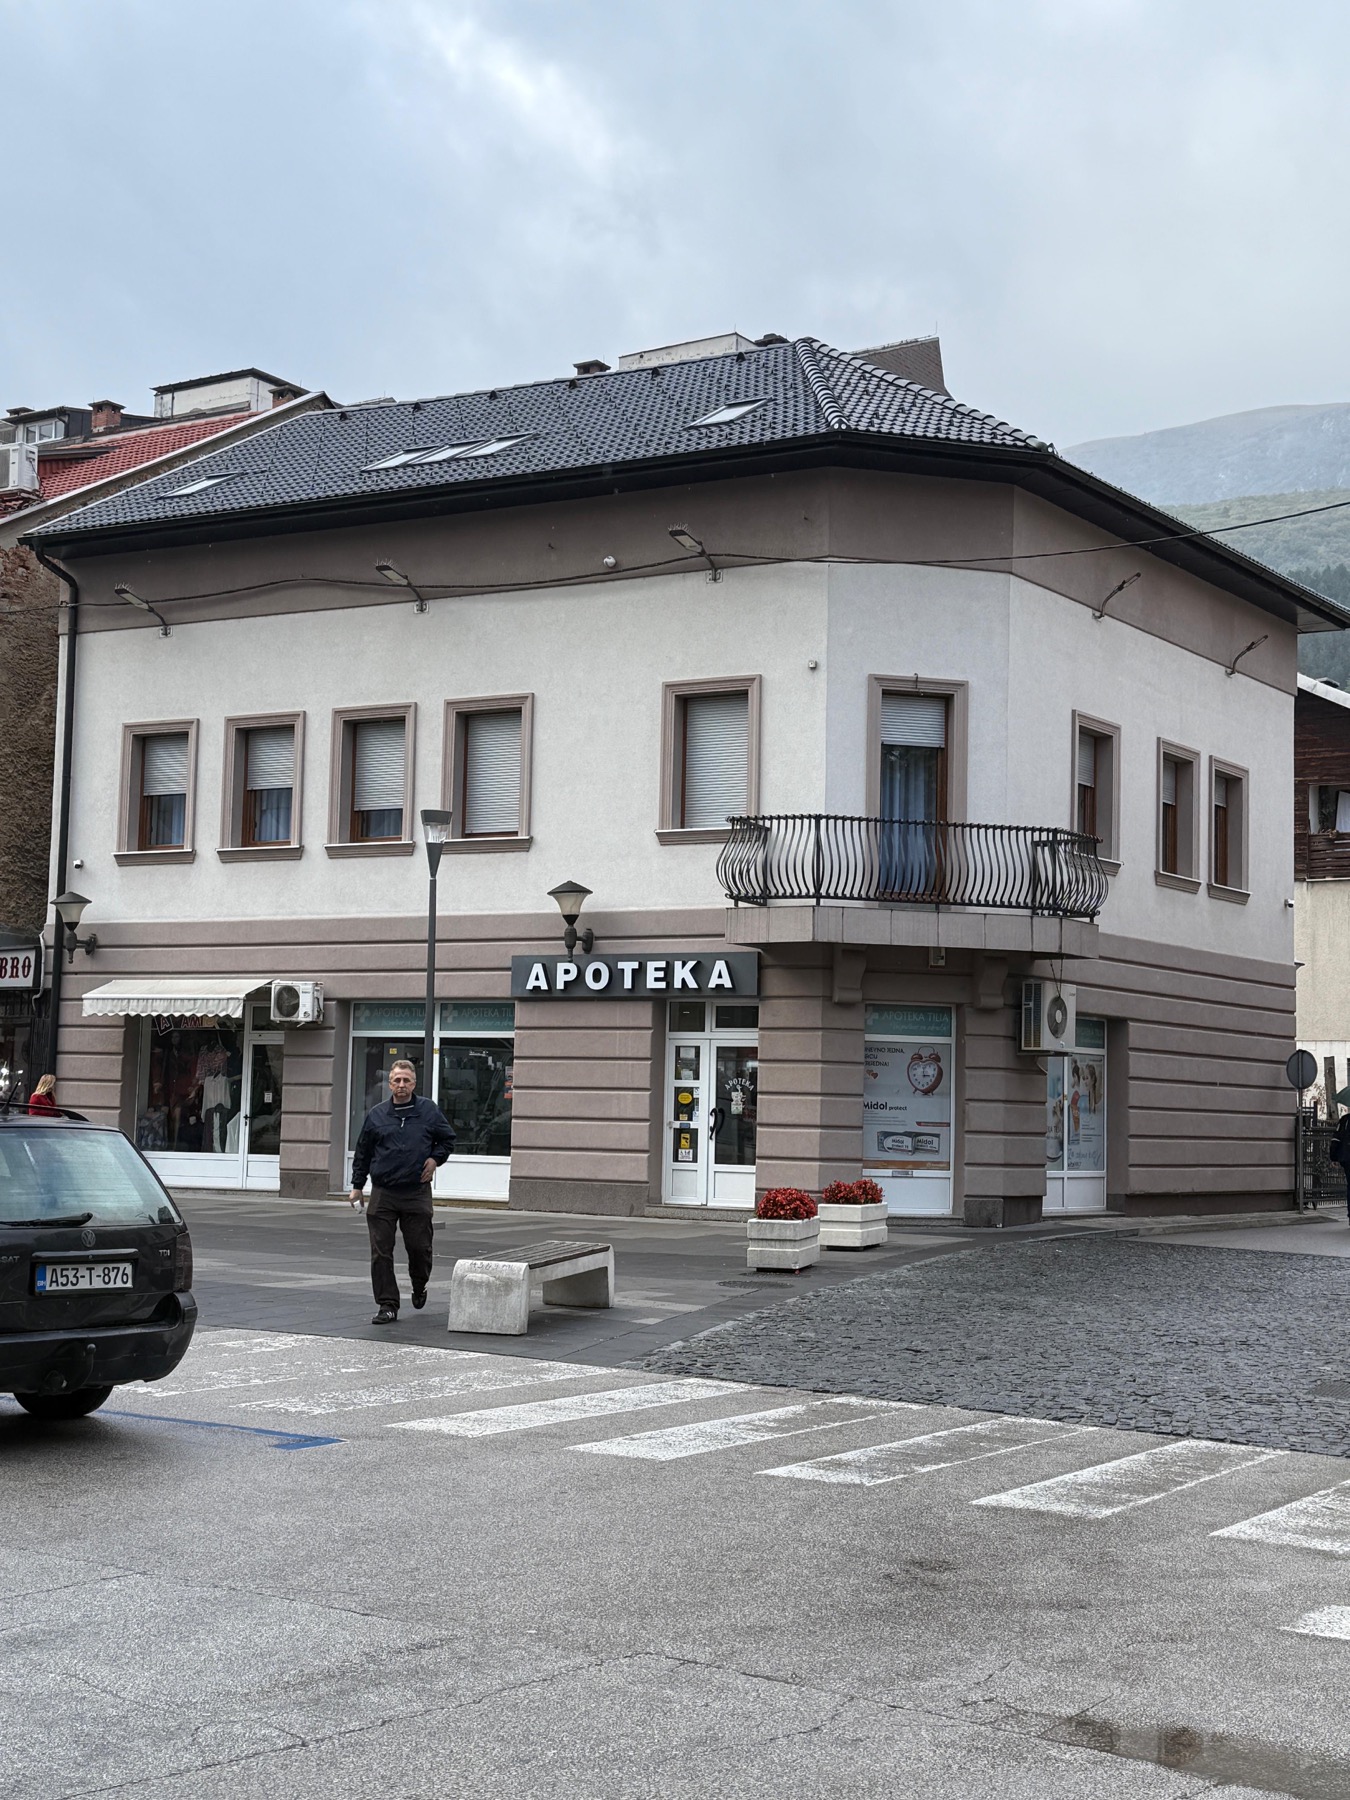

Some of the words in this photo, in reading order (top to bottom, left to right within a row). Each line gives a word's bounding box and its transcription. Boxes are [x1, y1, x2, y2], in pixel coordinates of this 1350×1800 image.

[525, 960, 733, 991] APOTEKA
[372, 1007, 410, 1017] APOTEKA
[411, 1007, 426, 1017] TILI
[461, 1007, 499, 1018] APOTEKA
[881, 1010, 926, 1022] APOTEKA
[927, 1012, 949, 1022] TILIA
[725, 1077, 755, 1091] APOTEKA
[916, 1138, 934, 1146] Midol
[158, 1249, 171, 1257] TDI
[0, 1255, 21, 1264] SAT
[49, 1266, 129, 1288] A53-T-876
